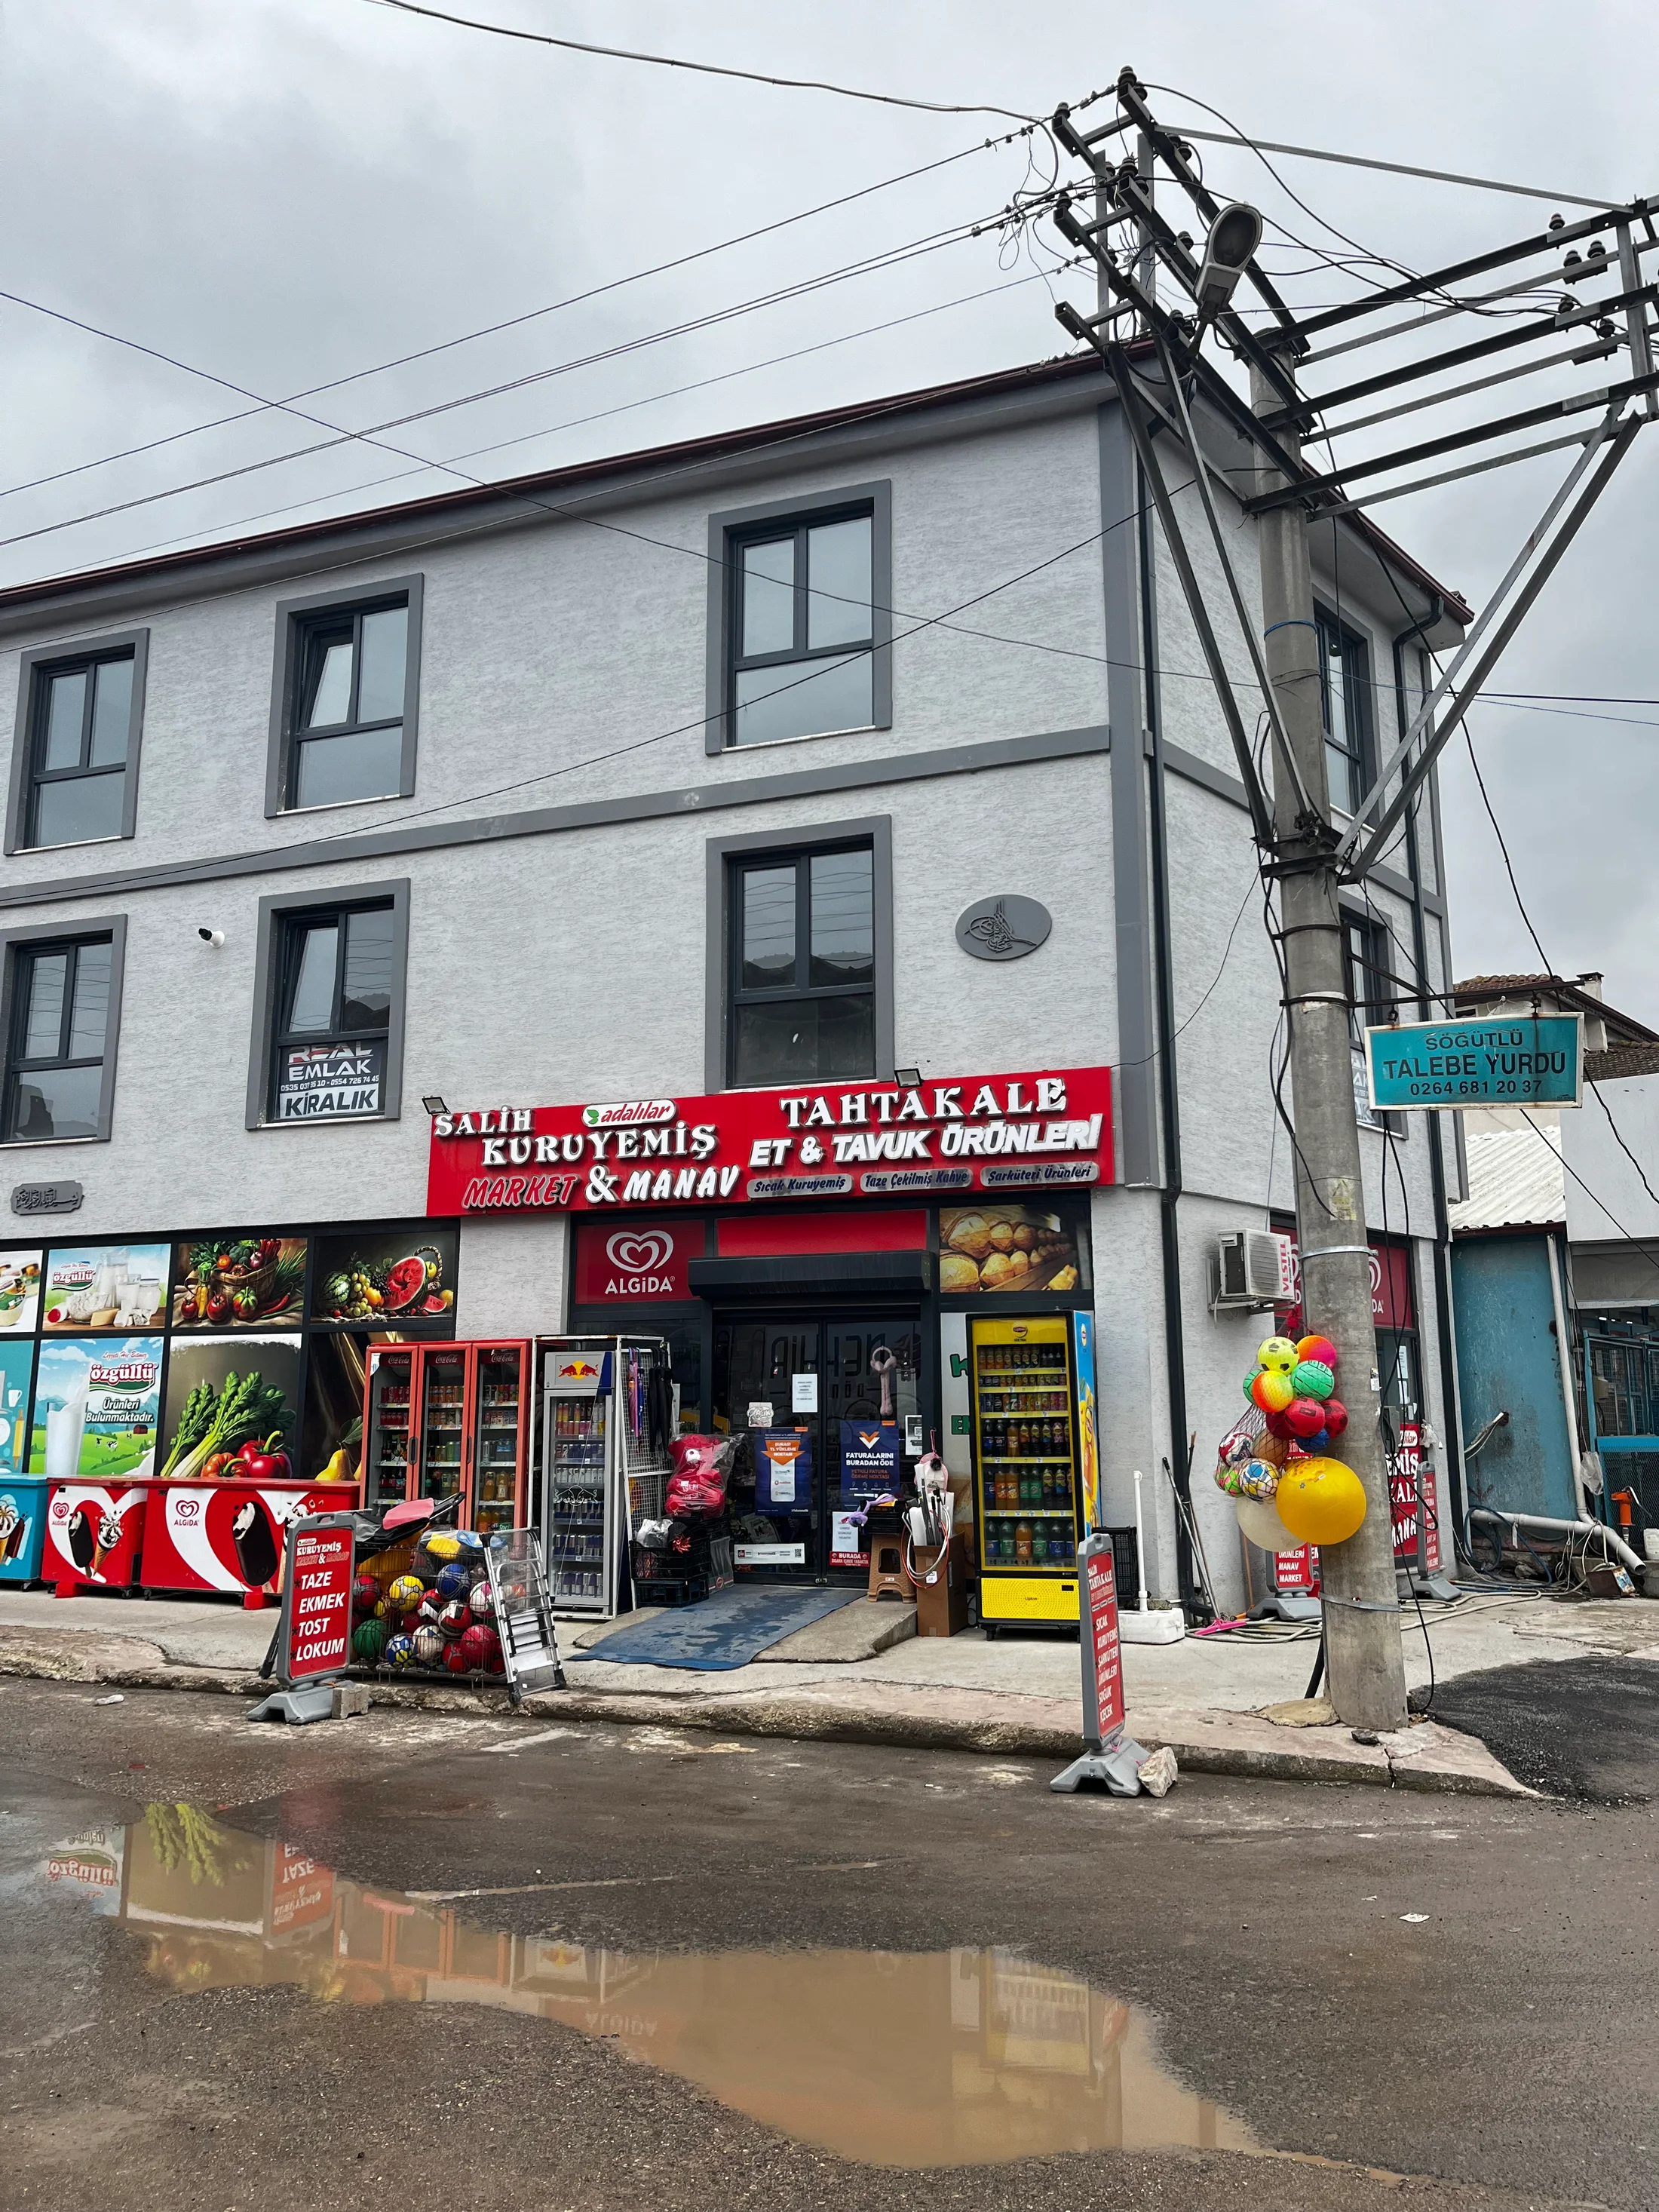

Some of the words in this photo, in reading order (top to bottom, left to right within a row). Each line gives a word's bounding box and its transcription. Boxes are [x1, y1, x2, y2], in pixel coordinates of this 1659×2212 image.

[1425, 1029, 1523, 1051] SÖĞÜTLÜ
[289, 1059, 371, 1081] EMLAK
[1383, 1054, 1477, 1079] TALEBE
[1484, 1052, 1565, 1075] YURDU
[299, 1082, 310, 1091] 037
[1410, 1081, 1454, 1096] 0264
[1459, 1081, 1488, 1094] 681
[1496, 1080, 1516, 1093] 20
[1522, 1079, 1542, 1093] 37
[285, 1089, 376, 1116] KİRALIK
[601, 1102, 670, 1122] adalılar
[780, 1078, 1067, 1127] TAHTAKALE
[434, 1107, 532, 1137] SALİH
[482, 1121, 716, 1166] KURUYEMİŞ
[749, 1137, 791, 1167] ET
[799, 1136, 823, 1164] &
[834, 1130, 931, 1161] TAVUK
[940, 1114, 1103, 1156] ÜRÜNLERİ
[865, 1175, 888, 1188] Taze
[891, 1172, 932, 1189] Çekilmiş
[936, 1170, 968, 1184] Kahve
[987, 1167, 1041, 1186] Şarküteri
[1044, 1164, 1093, 1180] Ürünleri
[463, 1175, 577, 1208] MARKET
[585, 1164, 618, 1204] &
[623, 1165, 740, 1201] MANAV
[754, 1180, 785, 1194] Sıcak
[787, 1177, 846, 1193] Kuruyemiş
[1280, 1241, 1289, 1292] VESTEL
[54, 1271, 93, 1284] özgüllü
[90, 1363, 154, 1385] özgüllü
[103, 1397, 140, 1410] Ürünleri
[86, 1411, 155, 1423] Bulunmaktadır.
[296, 1541, 342, 1556] KURUYEMİŞ
[318, 1553, 326, 1564] &
[1278, 1562, 1299, 1570] MANAV
[301, 1571, 333, 1591] TAZE
[1279, 1574, 1302, 1582] MARKET
[299, 1592, 346, 1614] EKMEK
[299, 1617, 331, 1637] TOST
[1096, 1614, 1109, 1631] SICAK
[296, 1637, 345, 1661] LOKUM
